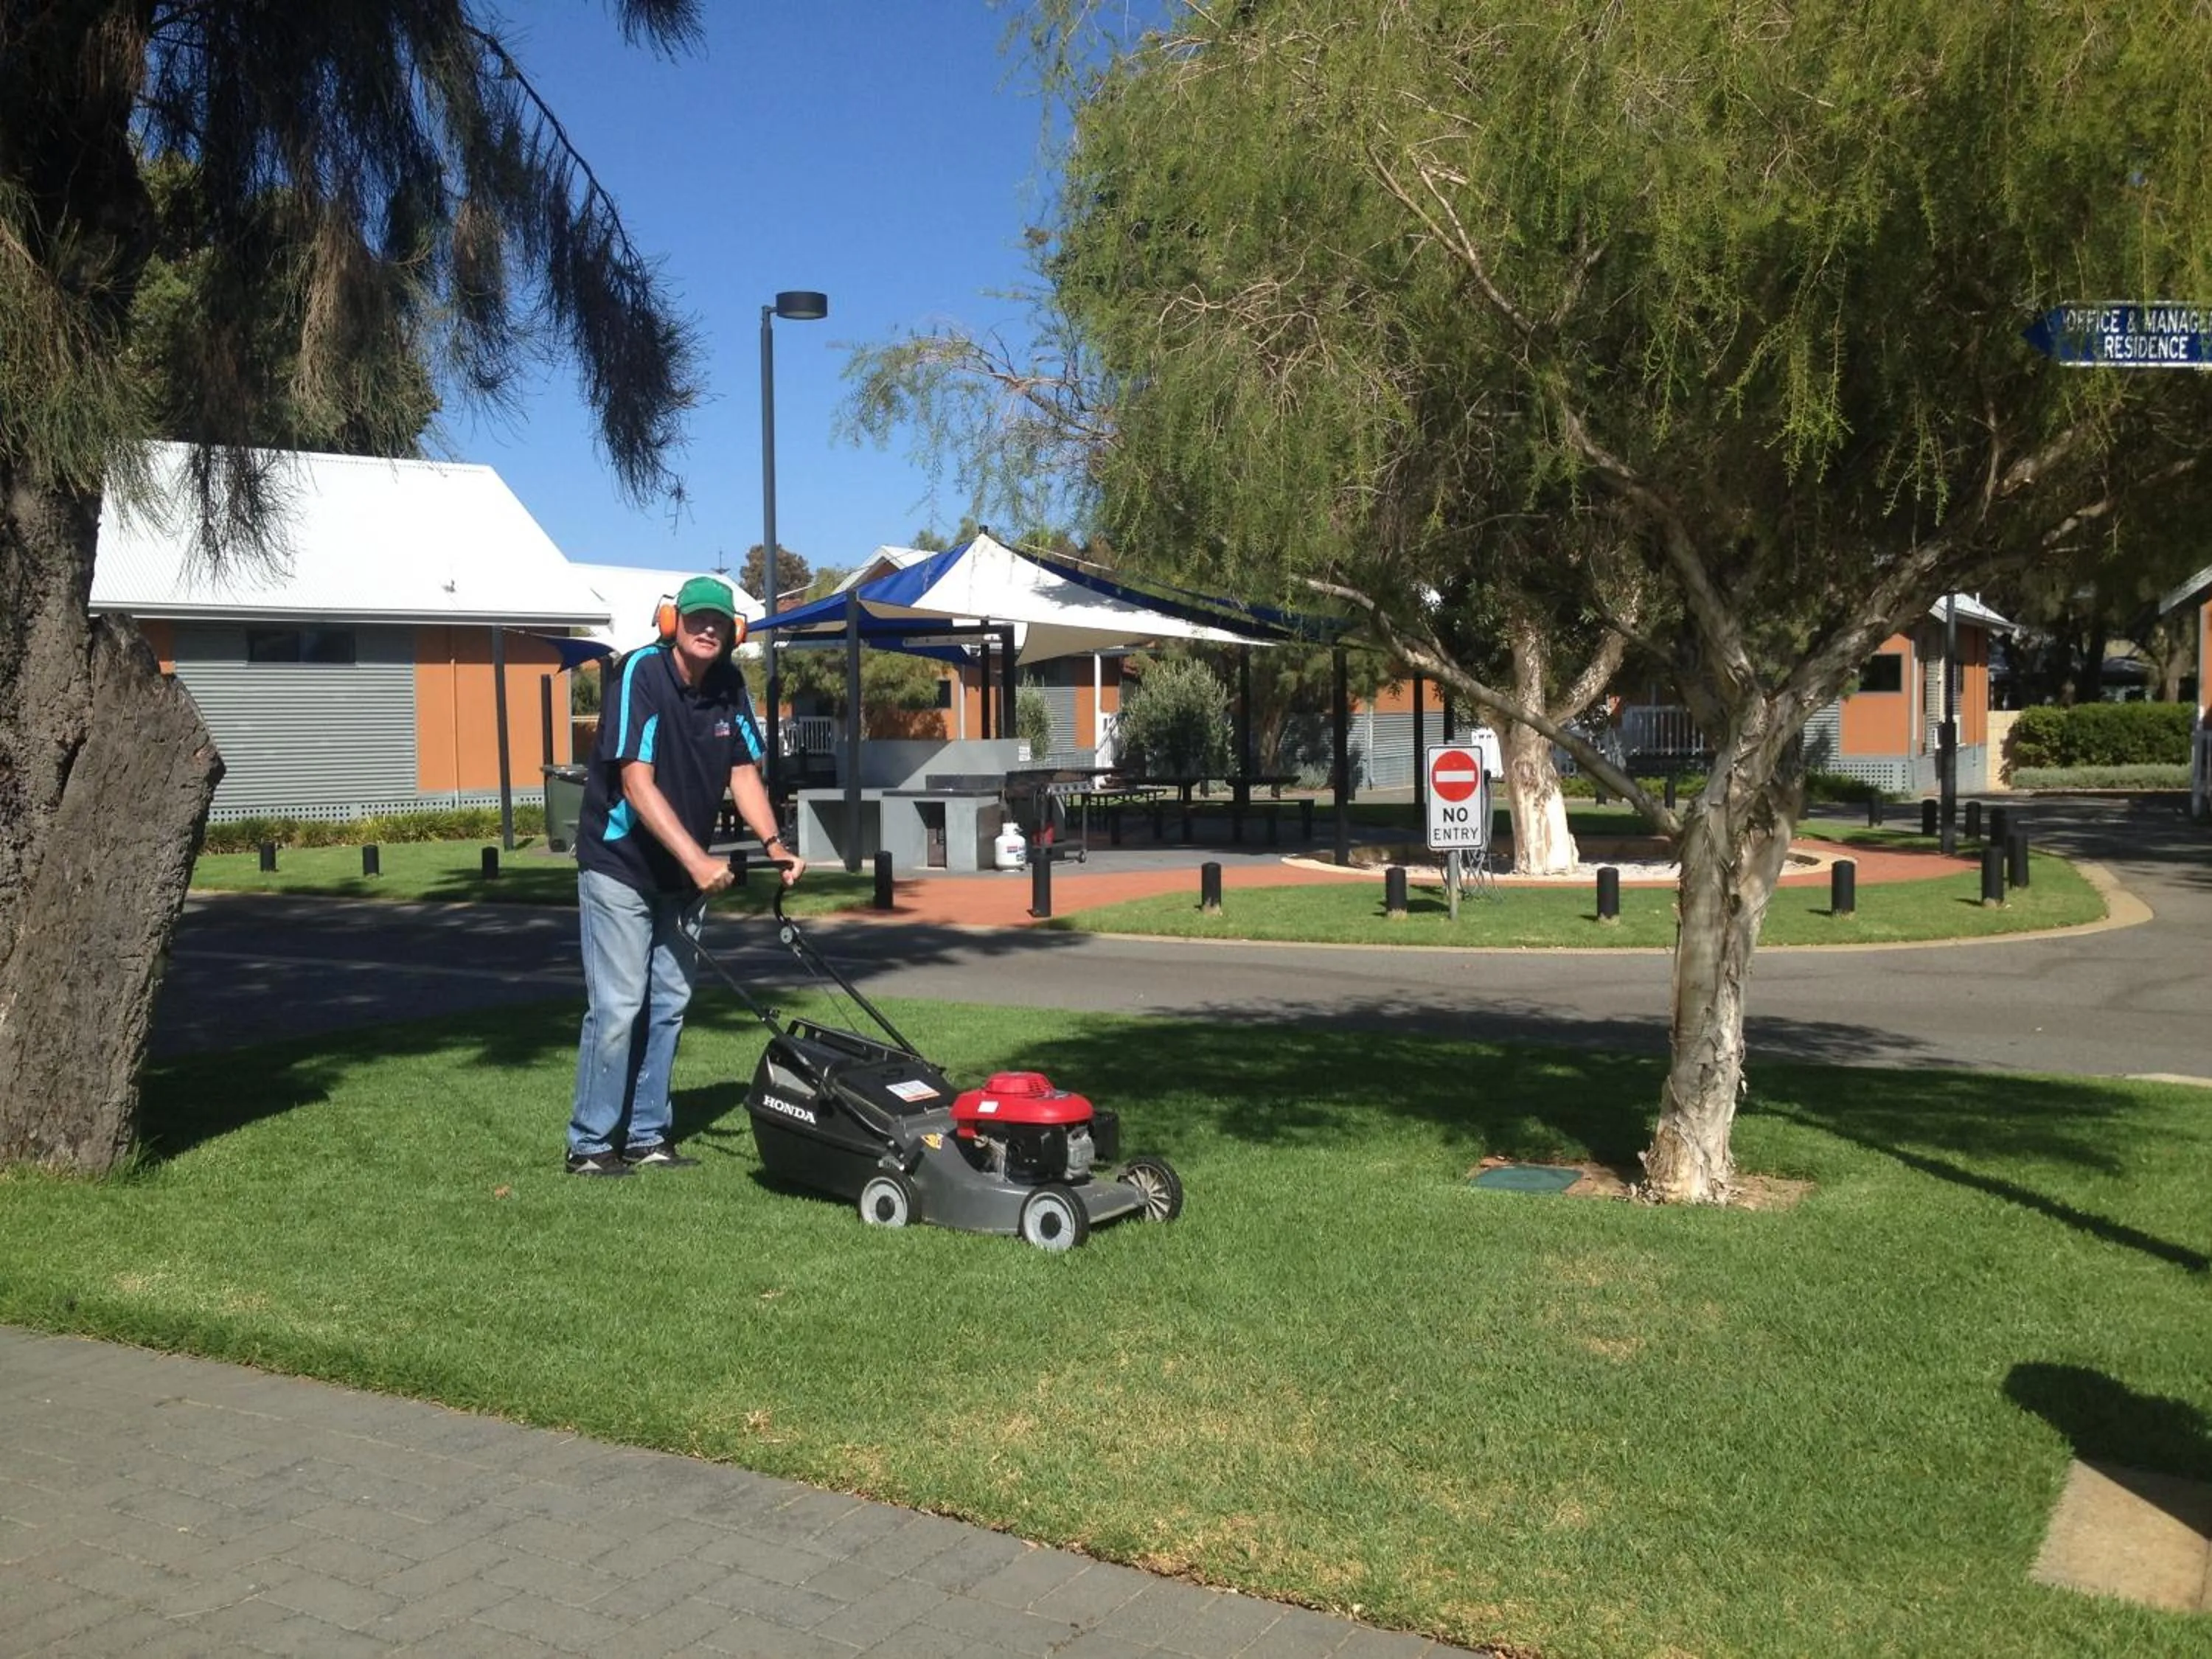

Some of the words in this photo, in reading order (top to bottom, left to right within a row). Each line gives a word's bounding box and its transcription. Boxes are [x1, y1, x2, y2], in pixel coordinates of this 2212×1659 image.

[2067, 310, 2120, 332] OFFICE
[2126, 310, 2137, 333] &
[2104, 335, 2188, 358] RESIDENCE
[1443, 807, 1468, 822] NO
[1433, 827, 1478, 841] ENTRY
[762, 1094, 816, 1124] HONDA
